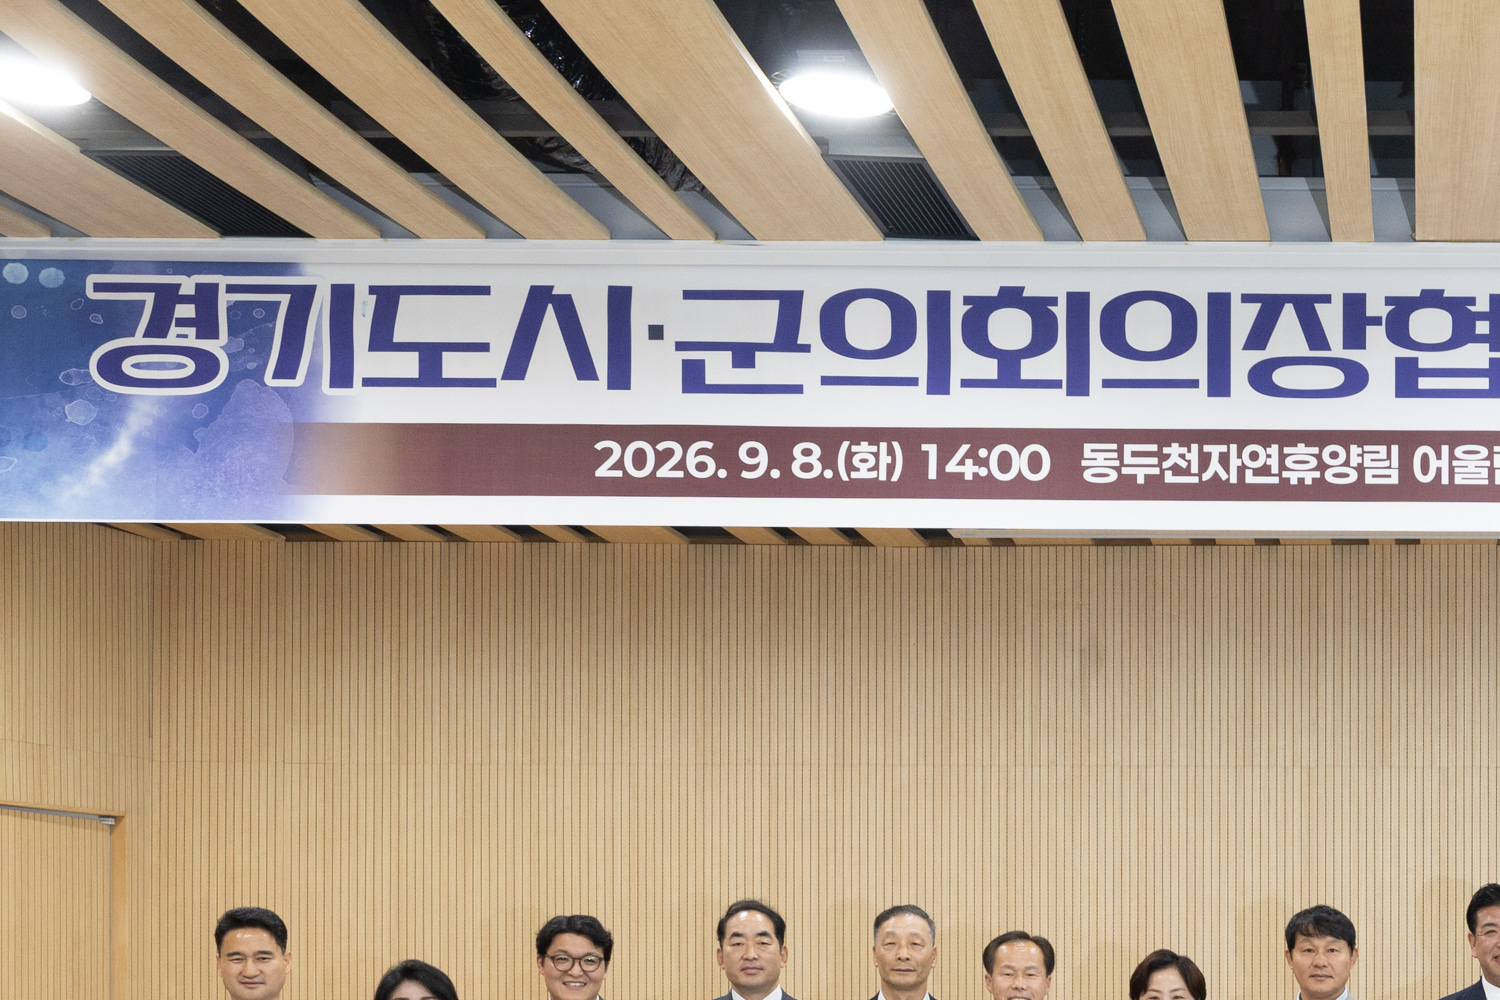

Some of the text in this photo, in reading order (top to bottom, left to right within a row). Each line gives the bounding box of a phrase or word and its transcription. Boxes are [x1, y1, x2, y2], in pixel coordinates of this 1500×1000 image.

[593, 440, 728, 479] 2026.
[739, 440, 781, 480] 9.
[791, 440, 903, 483] 8.(화)
[921, 443, 1051, 481] 14:00
[1081, 442, 1399, 485] 동두천자연휴양림
